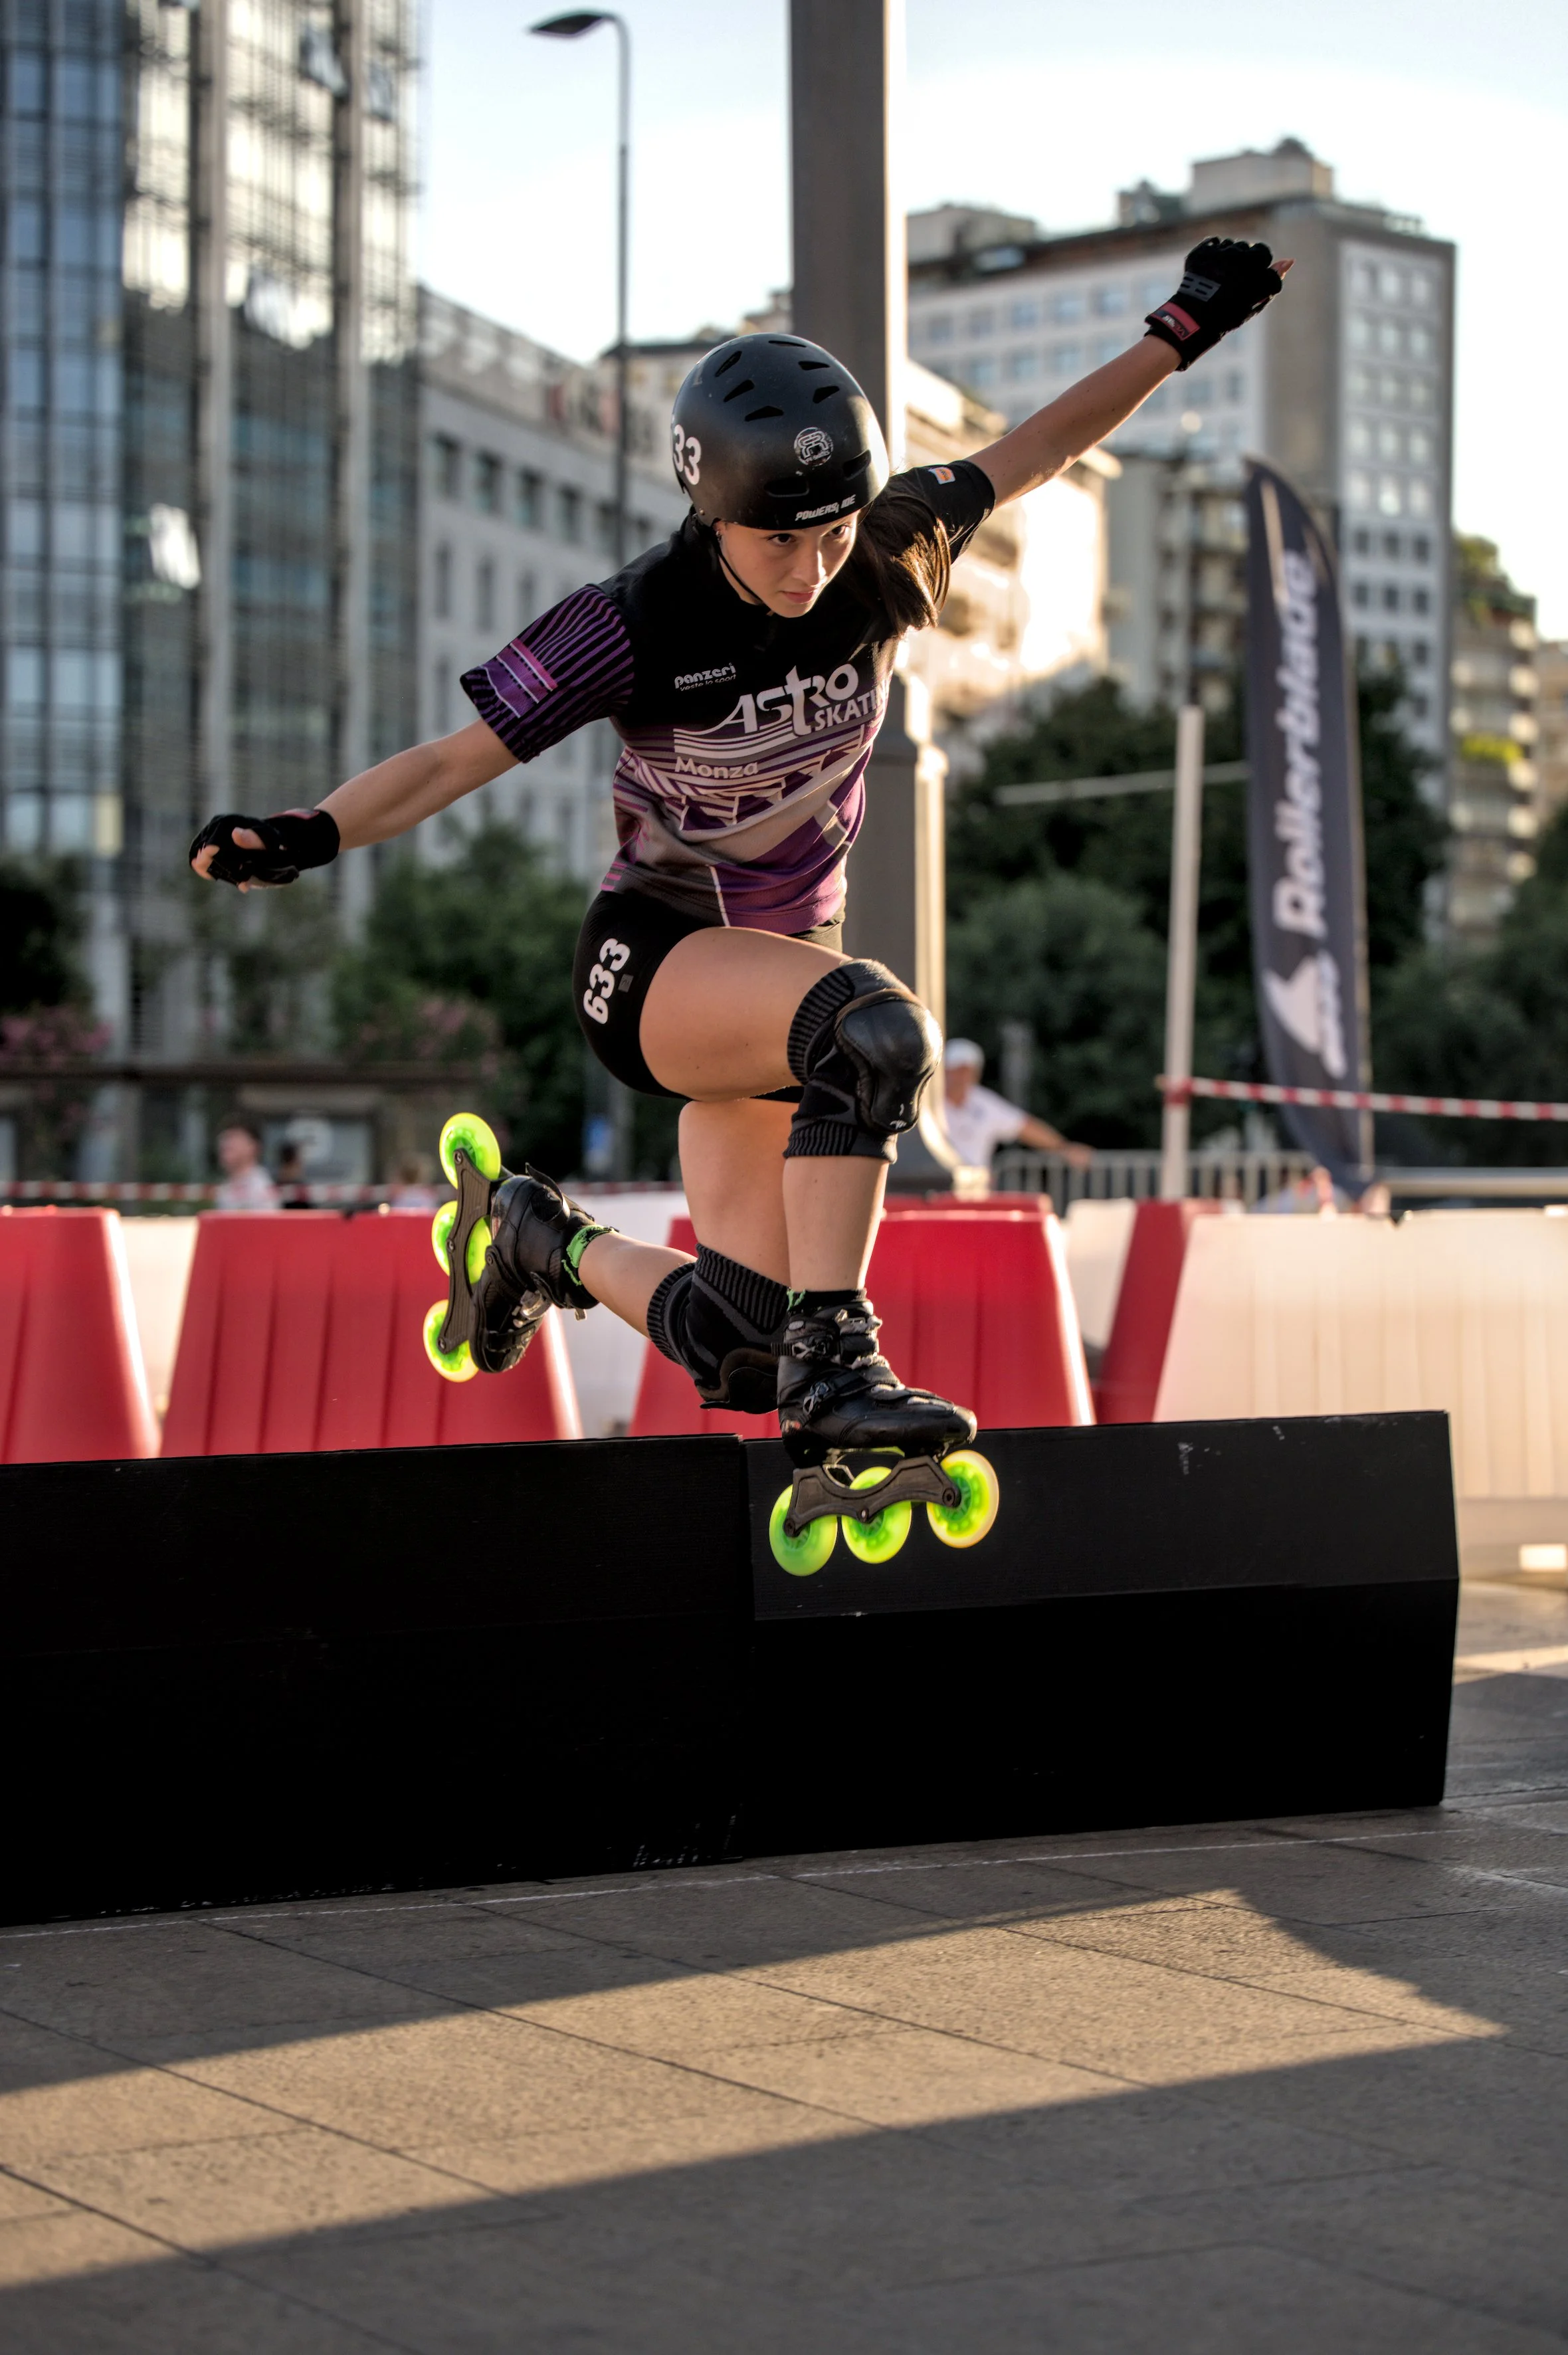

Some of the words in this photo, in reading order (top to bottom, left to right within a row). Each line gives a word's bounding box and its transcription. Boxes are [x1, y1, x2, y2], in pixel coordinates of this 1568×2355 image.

[672, 416, 702, 485] 33
[674, 663, 736, 689] panzeri
[680, 682, 704, 692] veste
[714, 674, 737, 684] sport
[1272, 548, 1326, 939] Rollerblade
[674, 756, 759, 779] Monza
[583, 938, 631, 1025] 633
